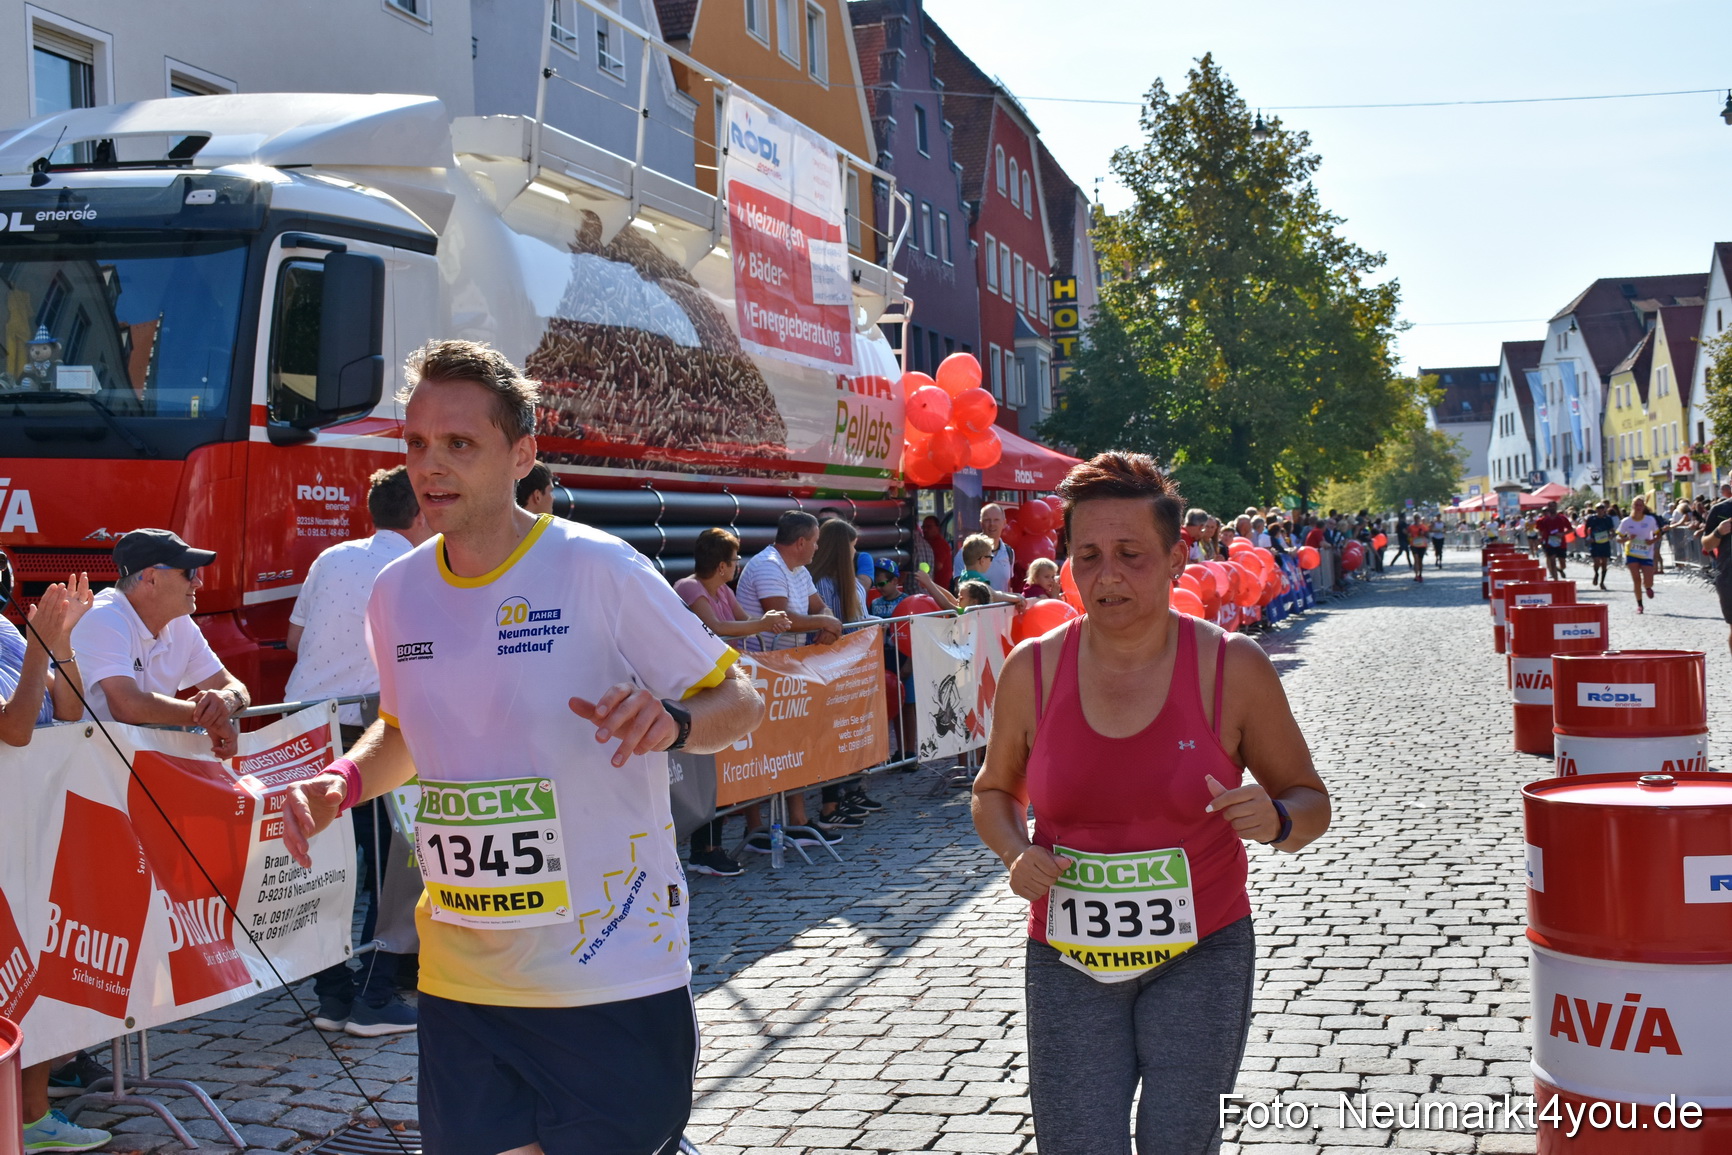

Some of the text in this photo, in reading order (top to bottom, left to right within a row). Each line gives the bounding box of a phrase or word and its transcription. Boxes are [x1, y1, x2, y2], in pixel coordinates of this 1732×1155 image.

[36, 203, 97, 221] energie
[746, 202, 804, 250] Heizungen
[749, 252, 782, 286] Bäder
[750, 302, 841, 356] Energieberatung
[832, 400, 893, 460] Pellets
[256, 569, 293, 582] 3243
[500, 603, 558, 626] 20 JAHRE
[498, 625, 570, 640] Neumarkter
[397, 642, 433, 658] BOCK
[497, 639, 555, 656] Stadtlauf
[773, 676, 808, 698] CODE
[769, 697, 812, 721] CLINIC
[723, 750, 805, 784] KreativAgentur
[234, 796, 245, 816] Seit
[425, 785, 538, 819] BOCK
[264, 854, 289, 869] Braun
[428, 831, 543, 877] 1345
[546, 832, 554, 841] D
[261, 872, 276, 887] Am
[1060, 856, 1172, 886] BOCK
[257, 886, 293, 903] D-92318
[440, 891, 544, 912] MANFRED
[252, 912, 267, 926] Tel.
[579, 871, 647, 965] 14./15. September 2019
[1061, 898, 1186, 938] 1333 D
[43, 902, 129, 977] Braun
[249, 930, 264, 944] Fax
[1068, 949, 1171, 967] KATHRIN
[4, 968, 38, 1019] Sicher ist sicher
[71, 967, 130, 997] Sicher ist sicher
